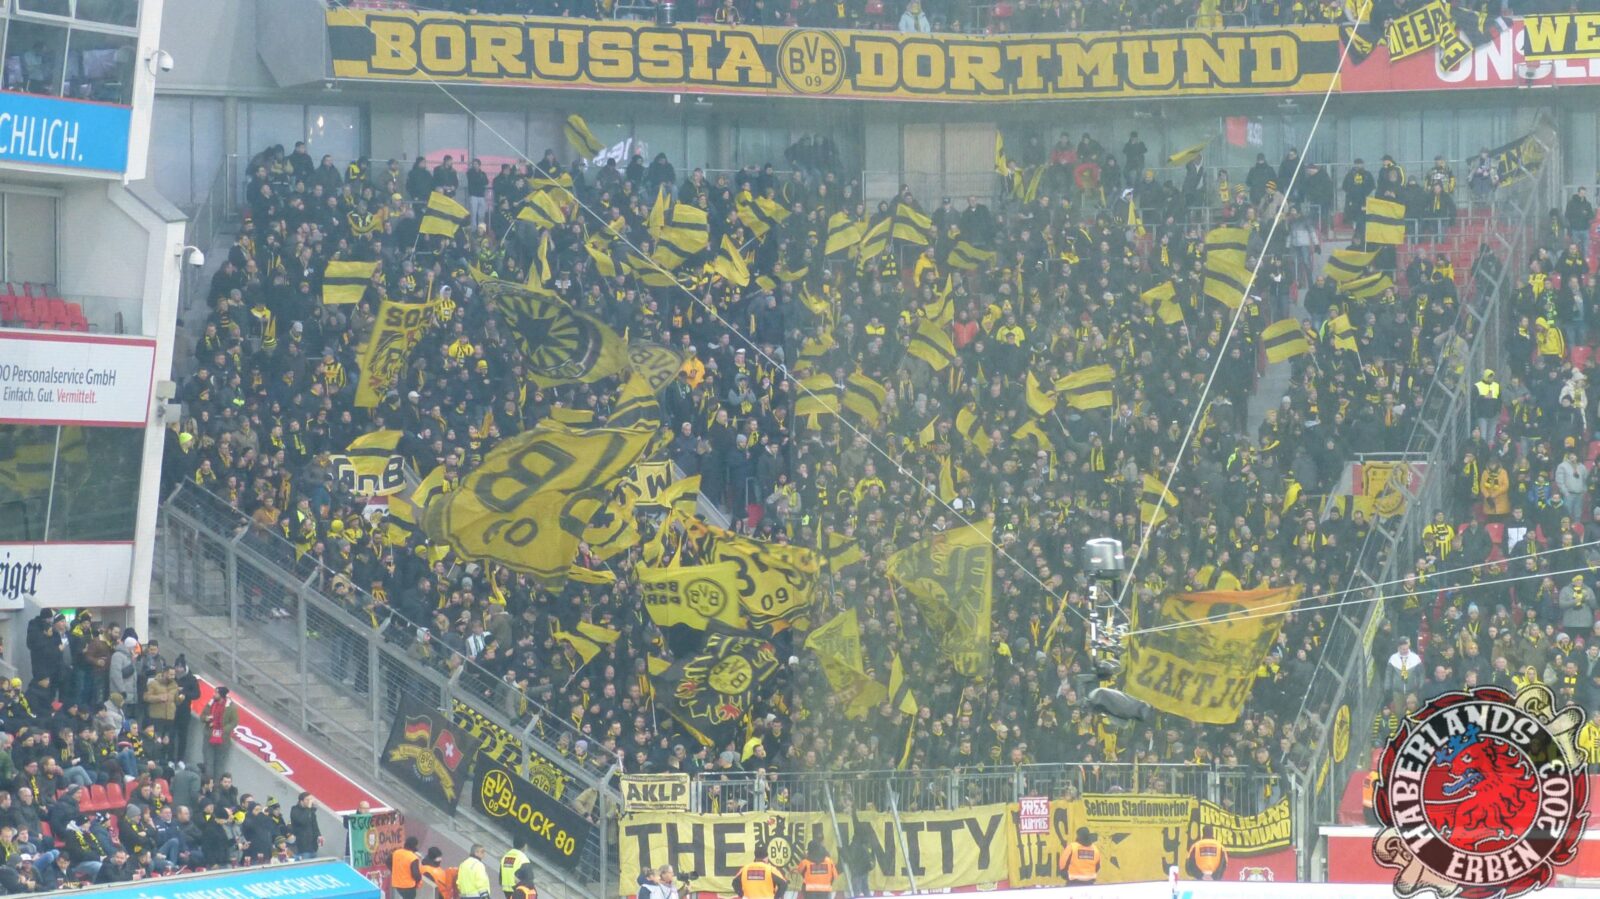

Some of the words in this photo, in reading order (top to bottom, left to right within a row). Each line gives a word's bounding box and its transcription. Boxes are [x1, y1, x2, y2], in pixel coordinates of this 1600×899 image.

[371, 20, 772, 83] BORUSSIA
[789, 36, 837, 76] BVB
[855, 36, 1299, 91] DORTMUND
[805, 76, 822, 87] 09
[12, 365, 84, 385] Personalservice
[86, 369, 117, 386] GmbH
[3, 386, 35, 402] Einfach.
[37, 388, 54, 403] Gut.
[57, 389, 97, 404] Vermittelt.
[627, 783, 686, 802] AKLP
[1021, 800, 1049, 815] FREE
[1085, 800, 1120, 816] Sektion
[1200, 800, 1290, 831] HOOLIGANS
[555, 830, 575, 855] 80
[625, 822, 746, 877] THE
[770, 841, 789, 858] BVB
